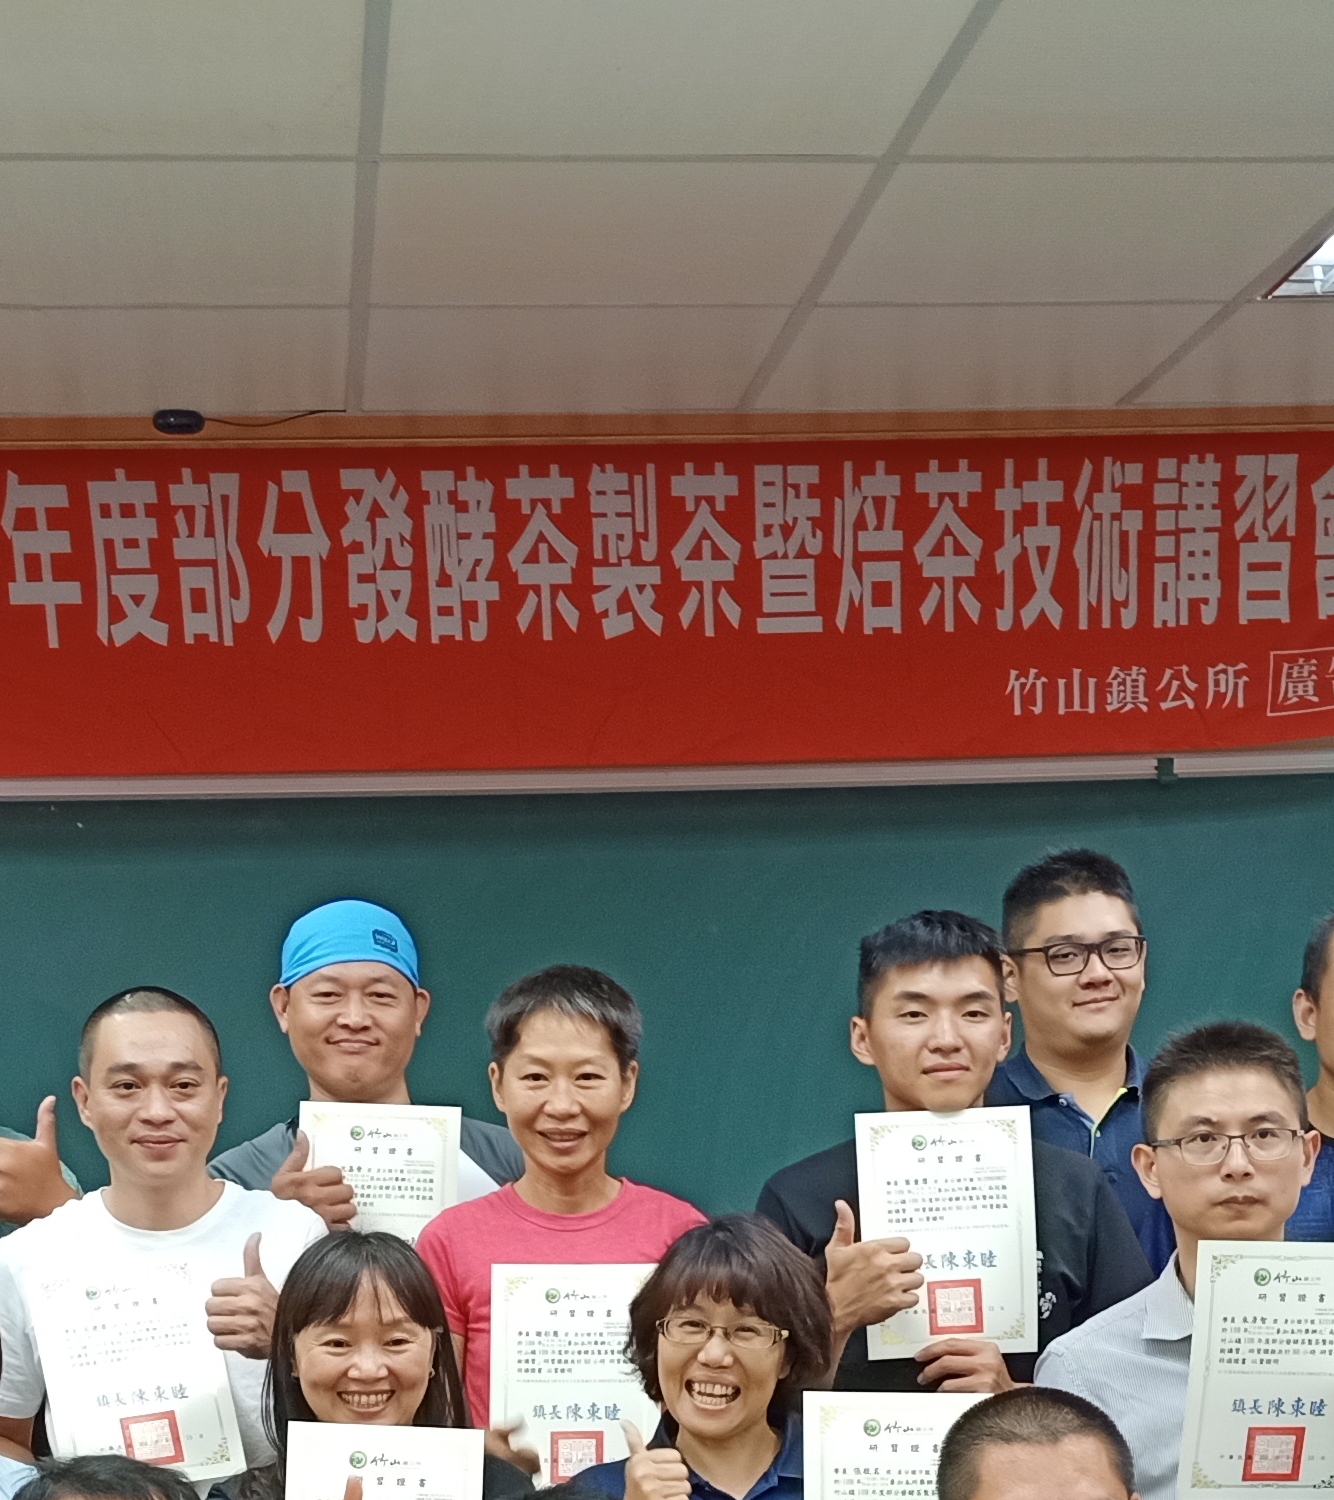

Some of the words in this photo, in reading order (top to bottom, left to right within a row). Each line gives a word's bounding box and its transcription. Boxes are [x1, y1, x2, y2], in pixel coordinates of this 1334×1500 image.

[1004, 661, 1249, 716] 竹山鎮公所
[923, 1248, 999, 1271] 長陳東睦
[532, 1402, 622, 1422] 鎮長陳東睦
[1231, 1396, 1329, 1418] 鎮長陳東睦
